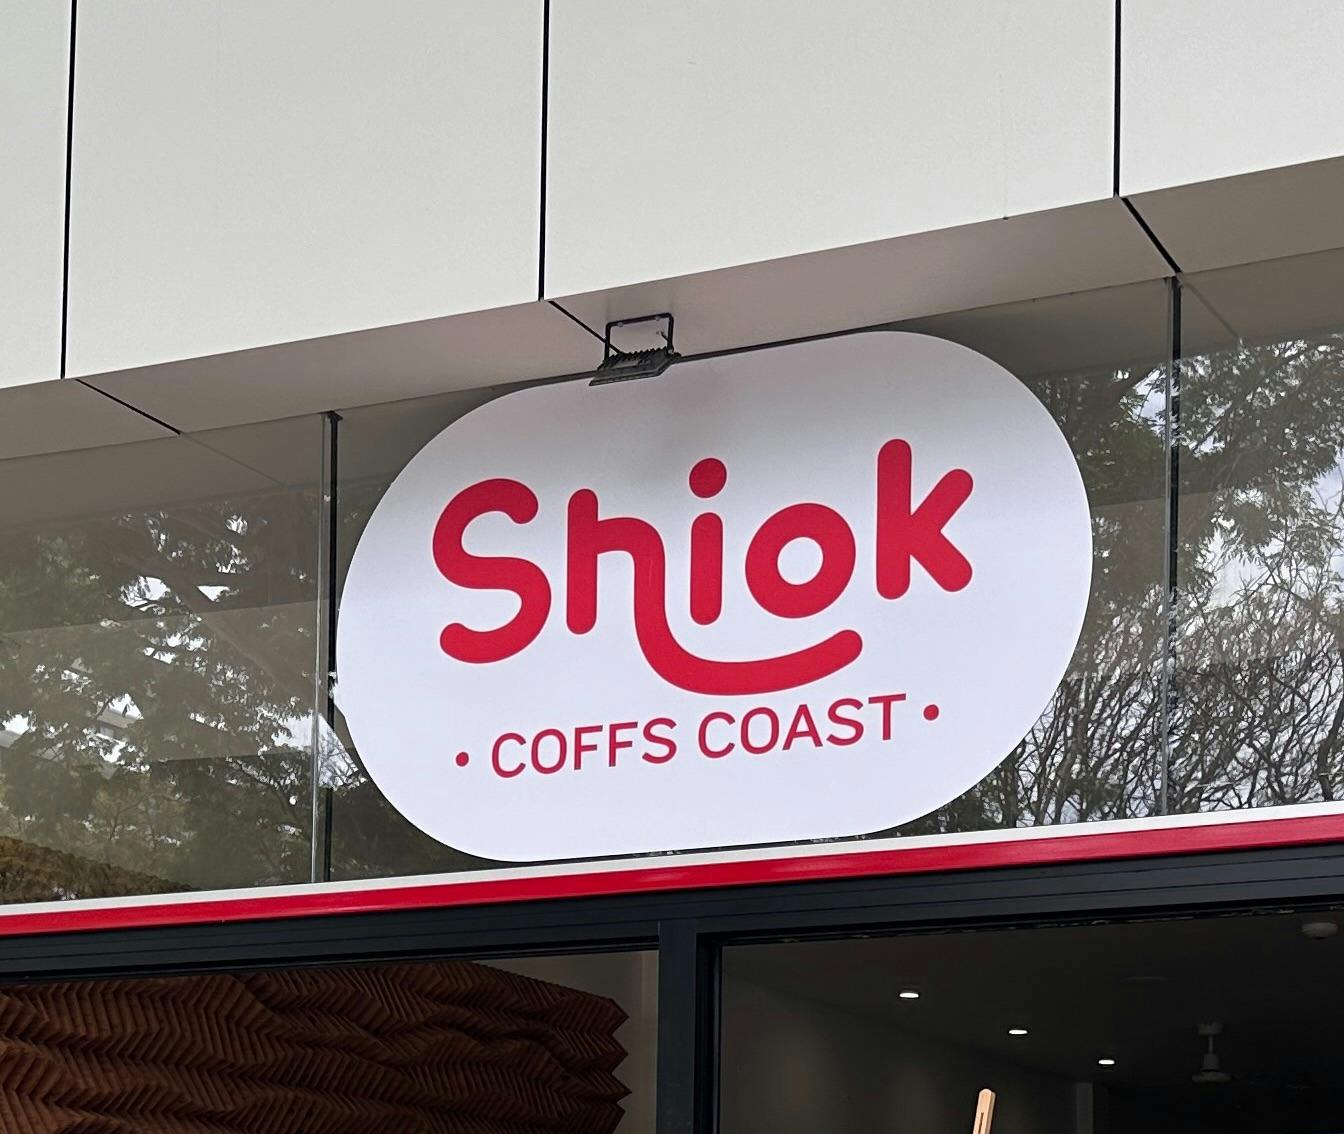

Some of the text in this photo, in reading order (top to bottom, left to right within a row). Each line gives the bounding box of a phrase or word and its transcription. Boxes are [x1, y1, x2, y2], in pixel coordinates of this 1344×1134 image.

[432, 438, 974, 696] Shiok
[491, 693, 907, 778] COFFS COAST
